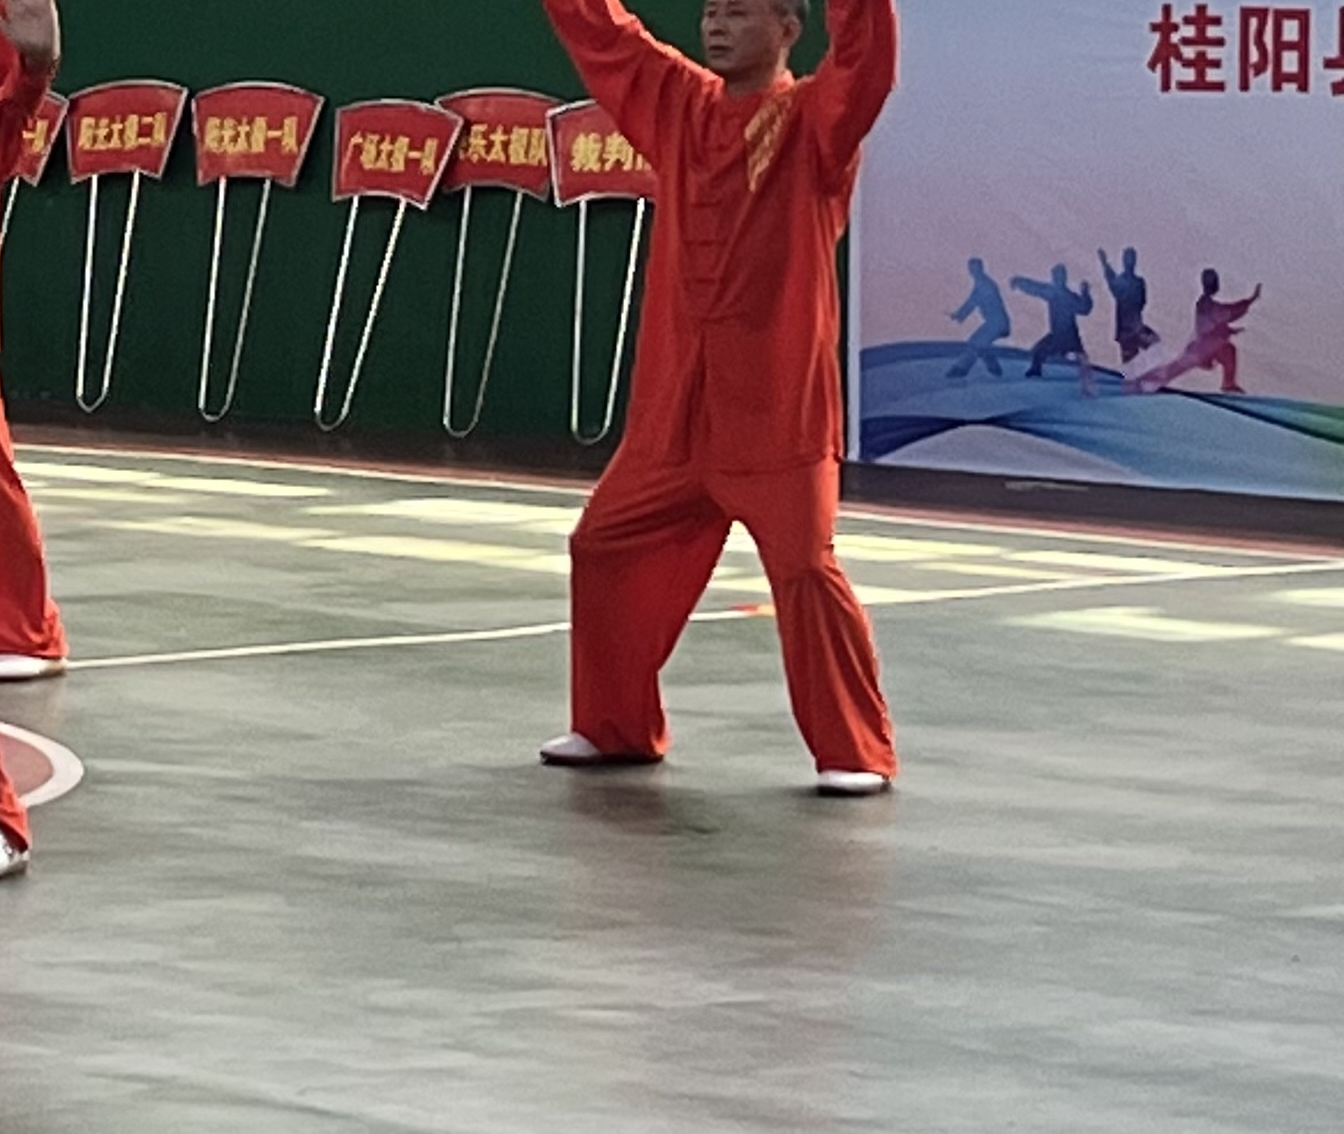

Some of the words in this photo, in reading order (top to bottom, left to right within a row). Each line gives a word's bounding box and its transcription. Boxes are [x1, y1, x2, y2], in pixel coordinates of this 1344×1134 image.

[1148, 4, 1344, 95] 桂阳
[459, 123, 548, 167] 乐太极队
[571, 131, 653, 172] 裁判
